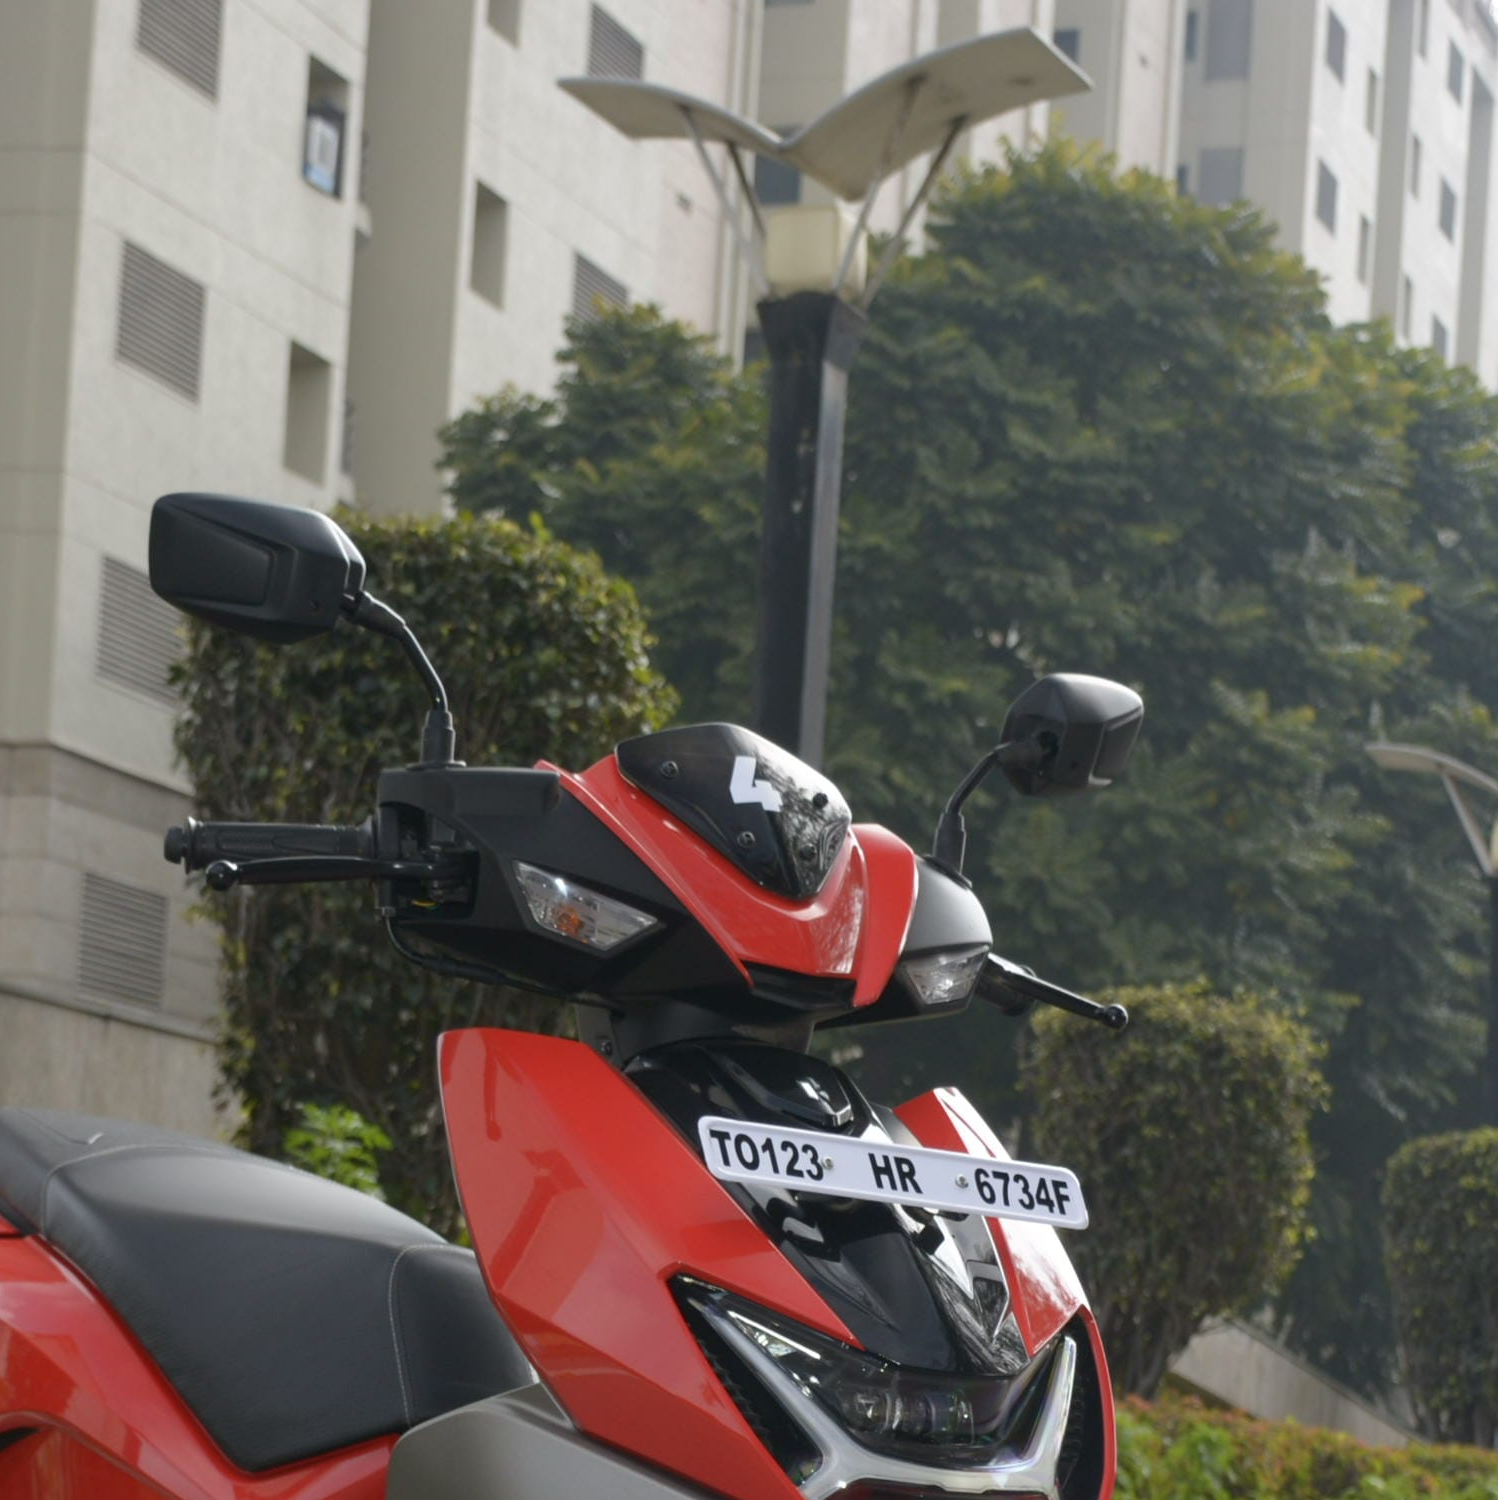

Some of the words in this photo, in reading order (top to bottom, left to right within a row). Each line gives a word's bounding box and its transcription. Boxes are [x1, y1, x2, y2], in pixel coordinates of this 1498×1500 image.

[709, 1129, 824, 1181] TO123
[868, 1152, 923, 1194] HR
[974, 1167, 1071, 1216] 6734F
